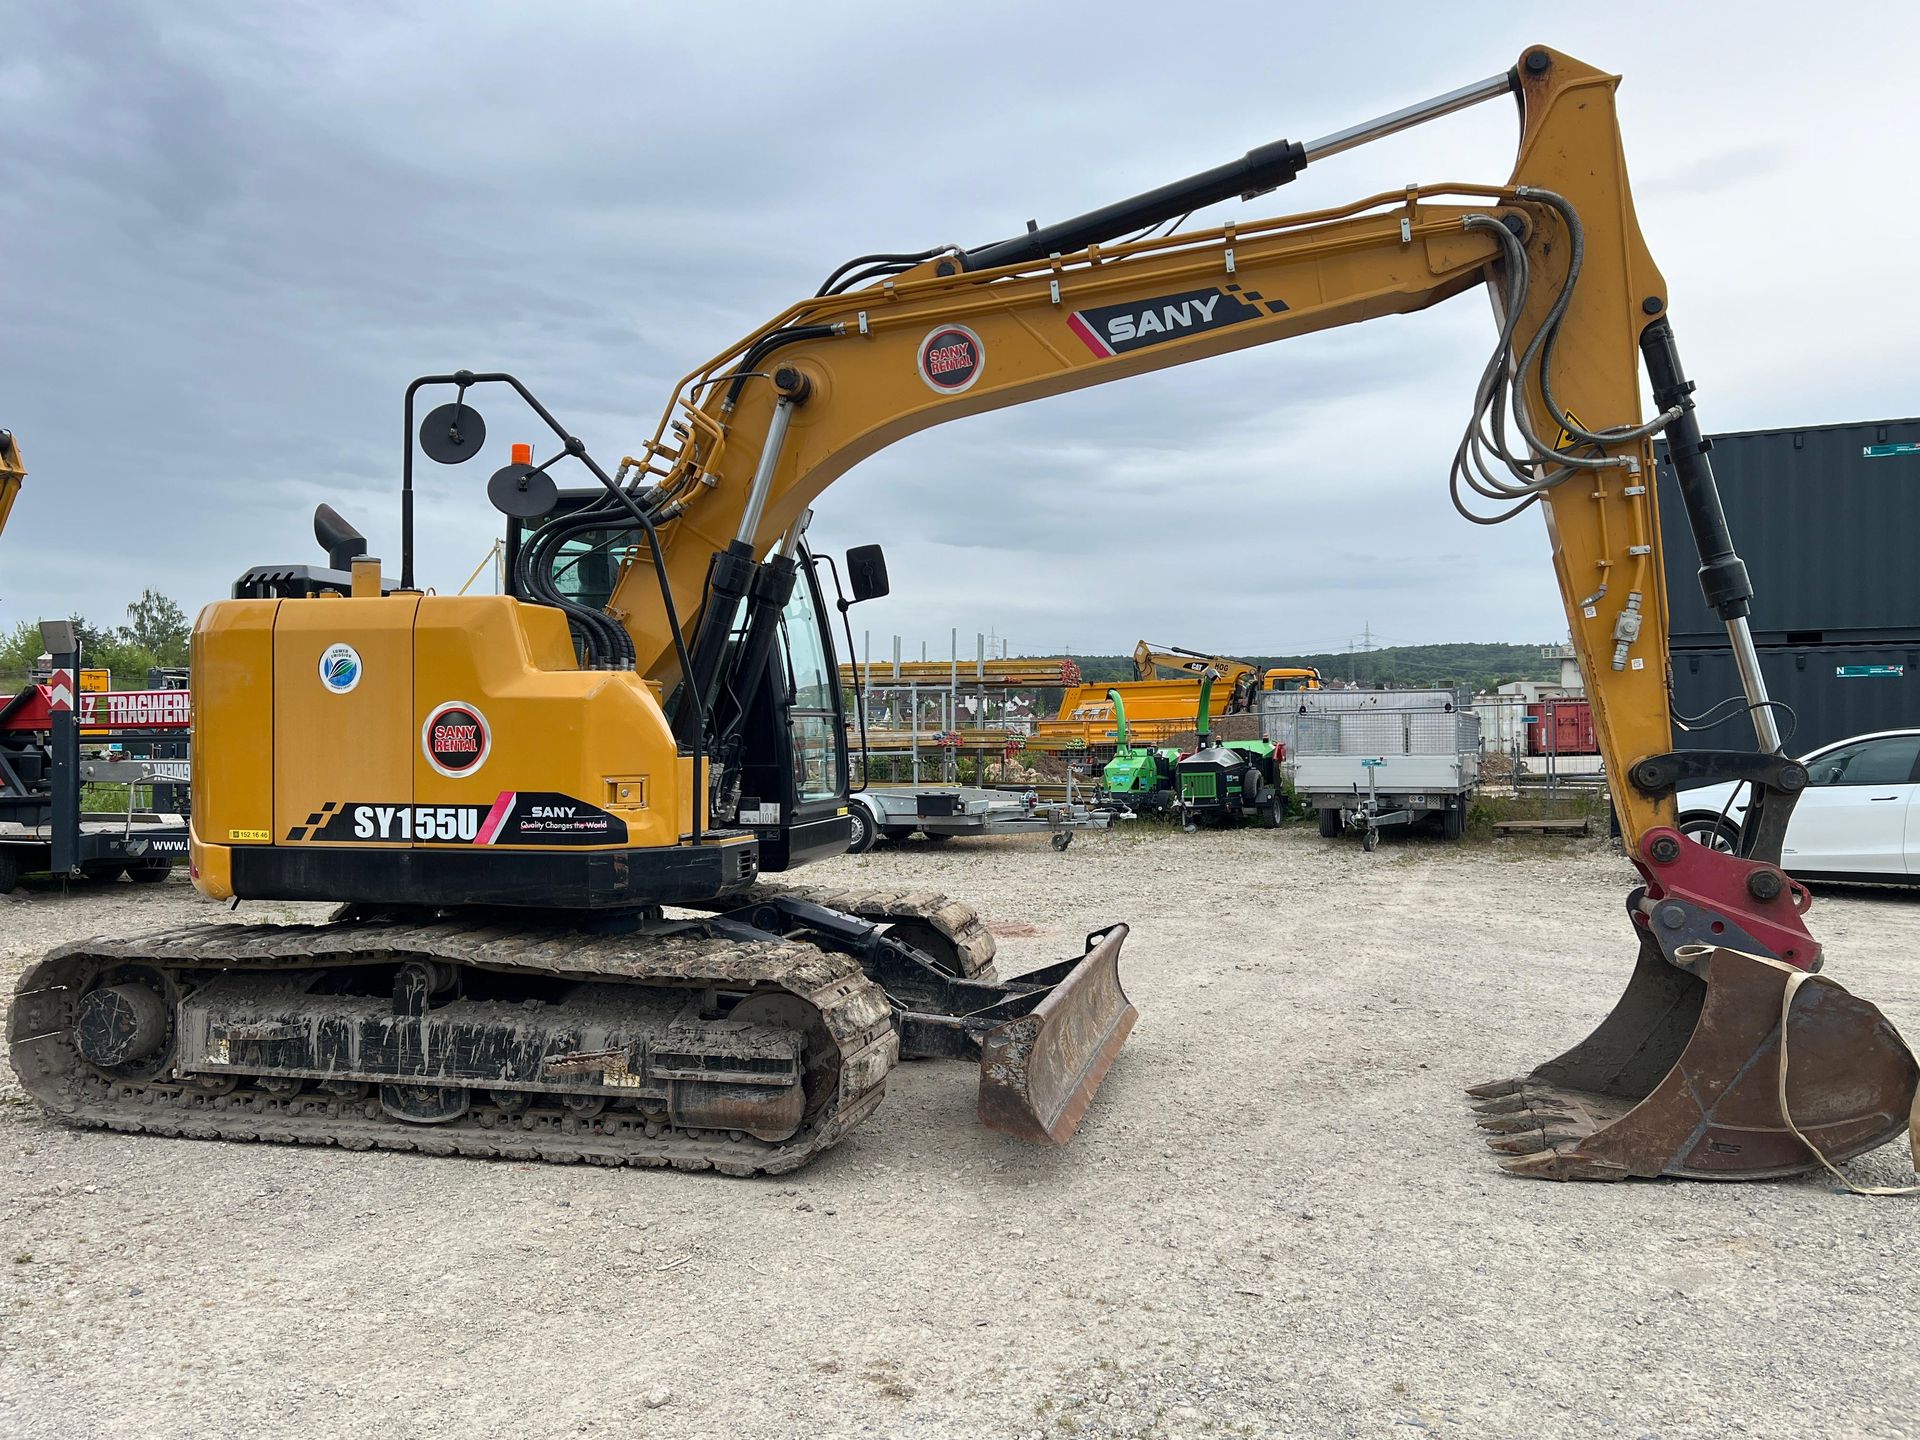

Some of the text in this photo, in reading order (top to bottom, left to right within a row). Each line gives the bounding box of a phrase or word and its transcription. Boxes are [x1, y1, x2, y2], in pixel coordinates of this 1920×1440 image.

[1107, 294, 1220, 343] SANY
[930, 342, 969, 362] SANY
[931, 355, 973, 375] RENTAL
[1191, 662, 1203, 671] CAT
[1214, 662, 1229, 672] HOG
[435, 725, 477, 739] SANY
[435, 739, 478, 752] RENTAL
[531, 806, 576, 818] SANY
[354, 806, 478, 840] SY155U
[520, 820, 608, 831] Quality Changes the World
